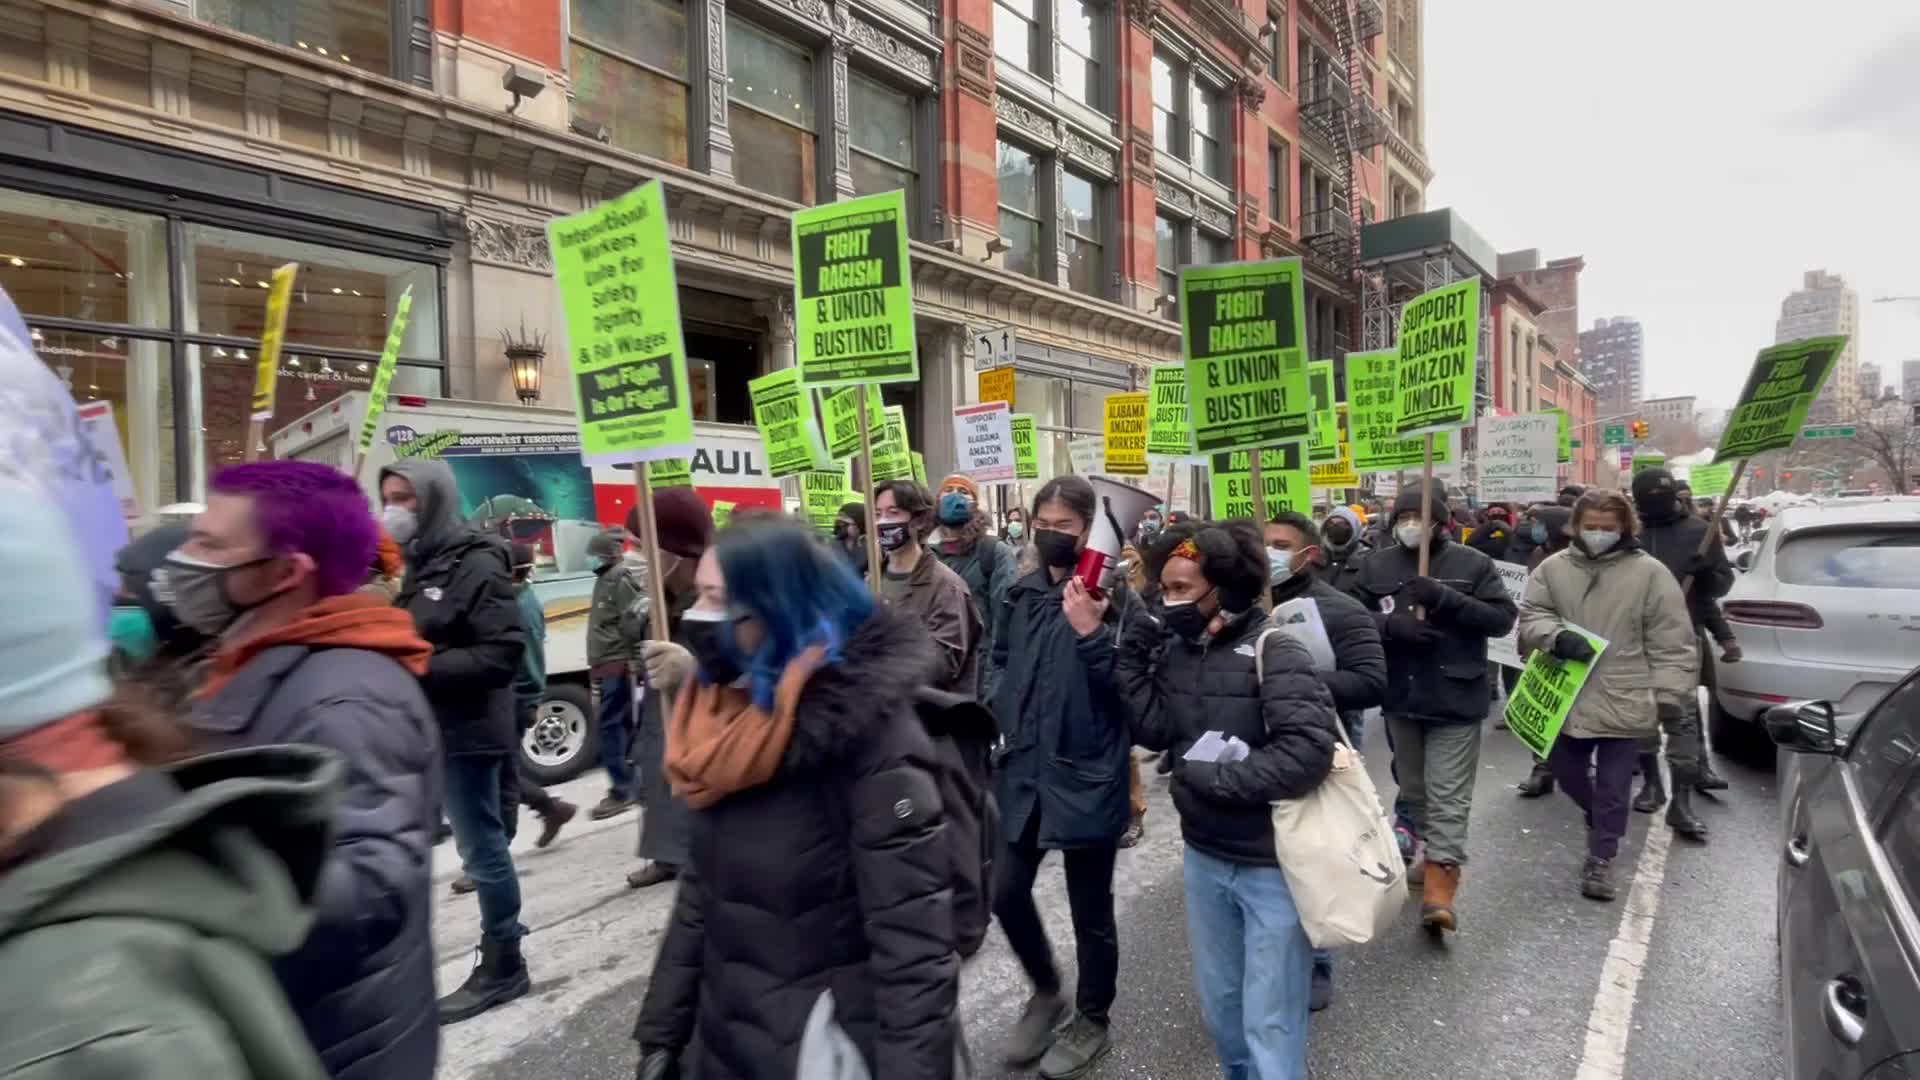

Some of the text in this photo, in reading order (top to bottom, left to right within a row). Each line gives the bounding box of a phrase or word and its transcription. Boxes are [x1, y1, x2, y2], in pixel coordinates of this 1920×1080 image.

[825, 228, 871, 261] FIGHT
[818, 258, 883, 293] RACISM
[816, 289, 886, 324] & UNION
[1216, 290, 1264, 321] FIGHT
[1404, 288, 1468, 333] SUPPORT
[814, 324, 893, 357] BUSTING!
[1209, 320, 1276, 352] RACISM
[1401, 319, 1467, 362] ALABAMA
[1156, 370, 1185, 382] amaz
[1207, 353, 1280, 388] & UNION
[1399, 350, 1465, 392] AMAZON
[1108, 405, 1145, 418] ALABAMA
[1205, 386, 1287, 423] BUSTING!
[1404, 380, 1455, 415] UNON
[965, 413, 997, 424] SUPPORT
[1110, 419, 1142, 433] AMAZON
[460, 434, 521, 445] NORTHWEST
[967, 432, 999, 444] ALABAMA
[969, 445, 1002, 456] AMAZON
[1108, 435, 1145, 450] WORKERS
[690, 447, 762, 476] AUL
[974, 456, 999, 467] UNION
[805, 474, 843, 490] UNION
[1228, 476, 1288, 497] & UION
